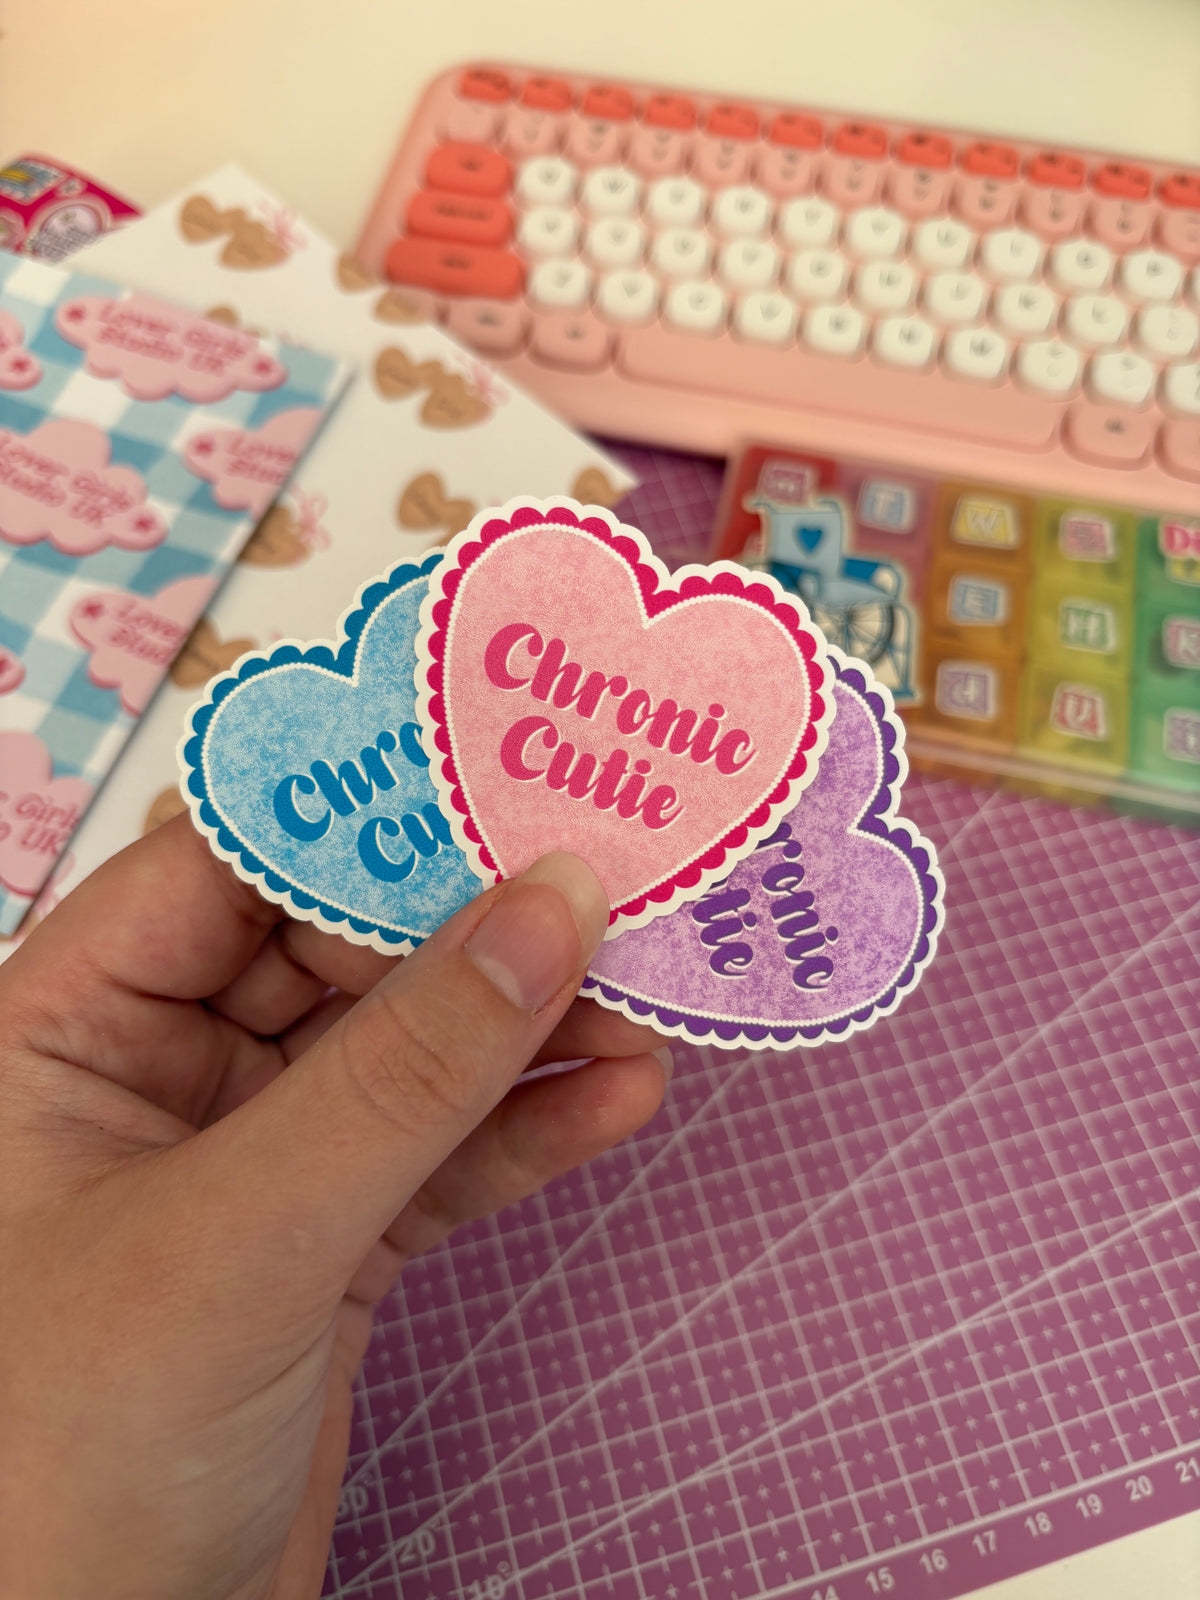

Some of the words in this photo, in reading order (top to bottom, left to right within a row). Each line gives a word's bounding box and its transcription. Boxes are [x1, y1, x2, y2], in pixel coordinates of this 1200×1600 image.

[113, 600, 191, 641] Love
[483, 622, 758, 777] Chronic
[500, 715, 685, 831] Cutie
[691, 878, 758, 980] tie
[865, 1566, 895, 1594] 15
[919, 1548, 948, 1575] 16
[971, 1529, 997, 1556] 17
[1023, 1511, 1053, 1538] 18
[1075, 1493, 1103, 1520] 19
[1124, 1475, 1153, 1502] 20
[1175, 1457, 1200, 1482] 21
